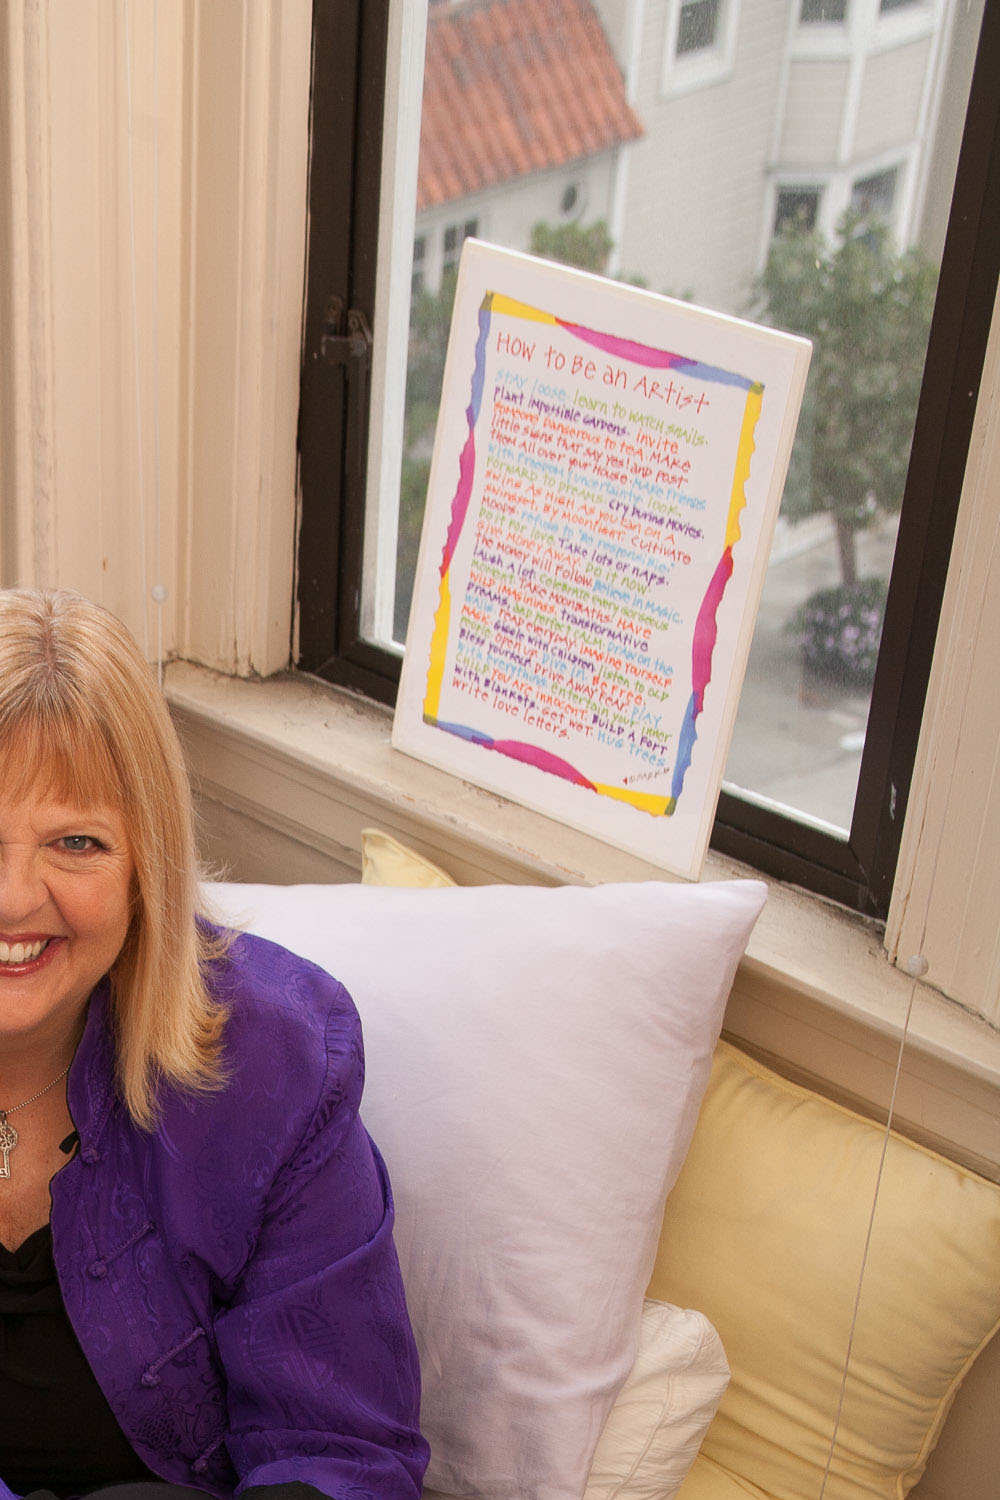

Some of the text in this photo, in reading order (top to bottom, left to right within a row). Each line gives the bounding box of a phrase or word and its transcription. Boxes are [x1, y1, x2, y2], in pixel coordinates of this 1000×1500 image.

[544, 344, 566, 370] to
[570, 354, 596, 380] Be
[602, 365, 627, 389] an
[567, 457, 592, 471] your
[597, 509, 618, 524] you
[605, 570, 617, 583] it
[632, 593, 643, 605] in
[634, 679, 645, 694] to
[492, 694, 519, 716] love
